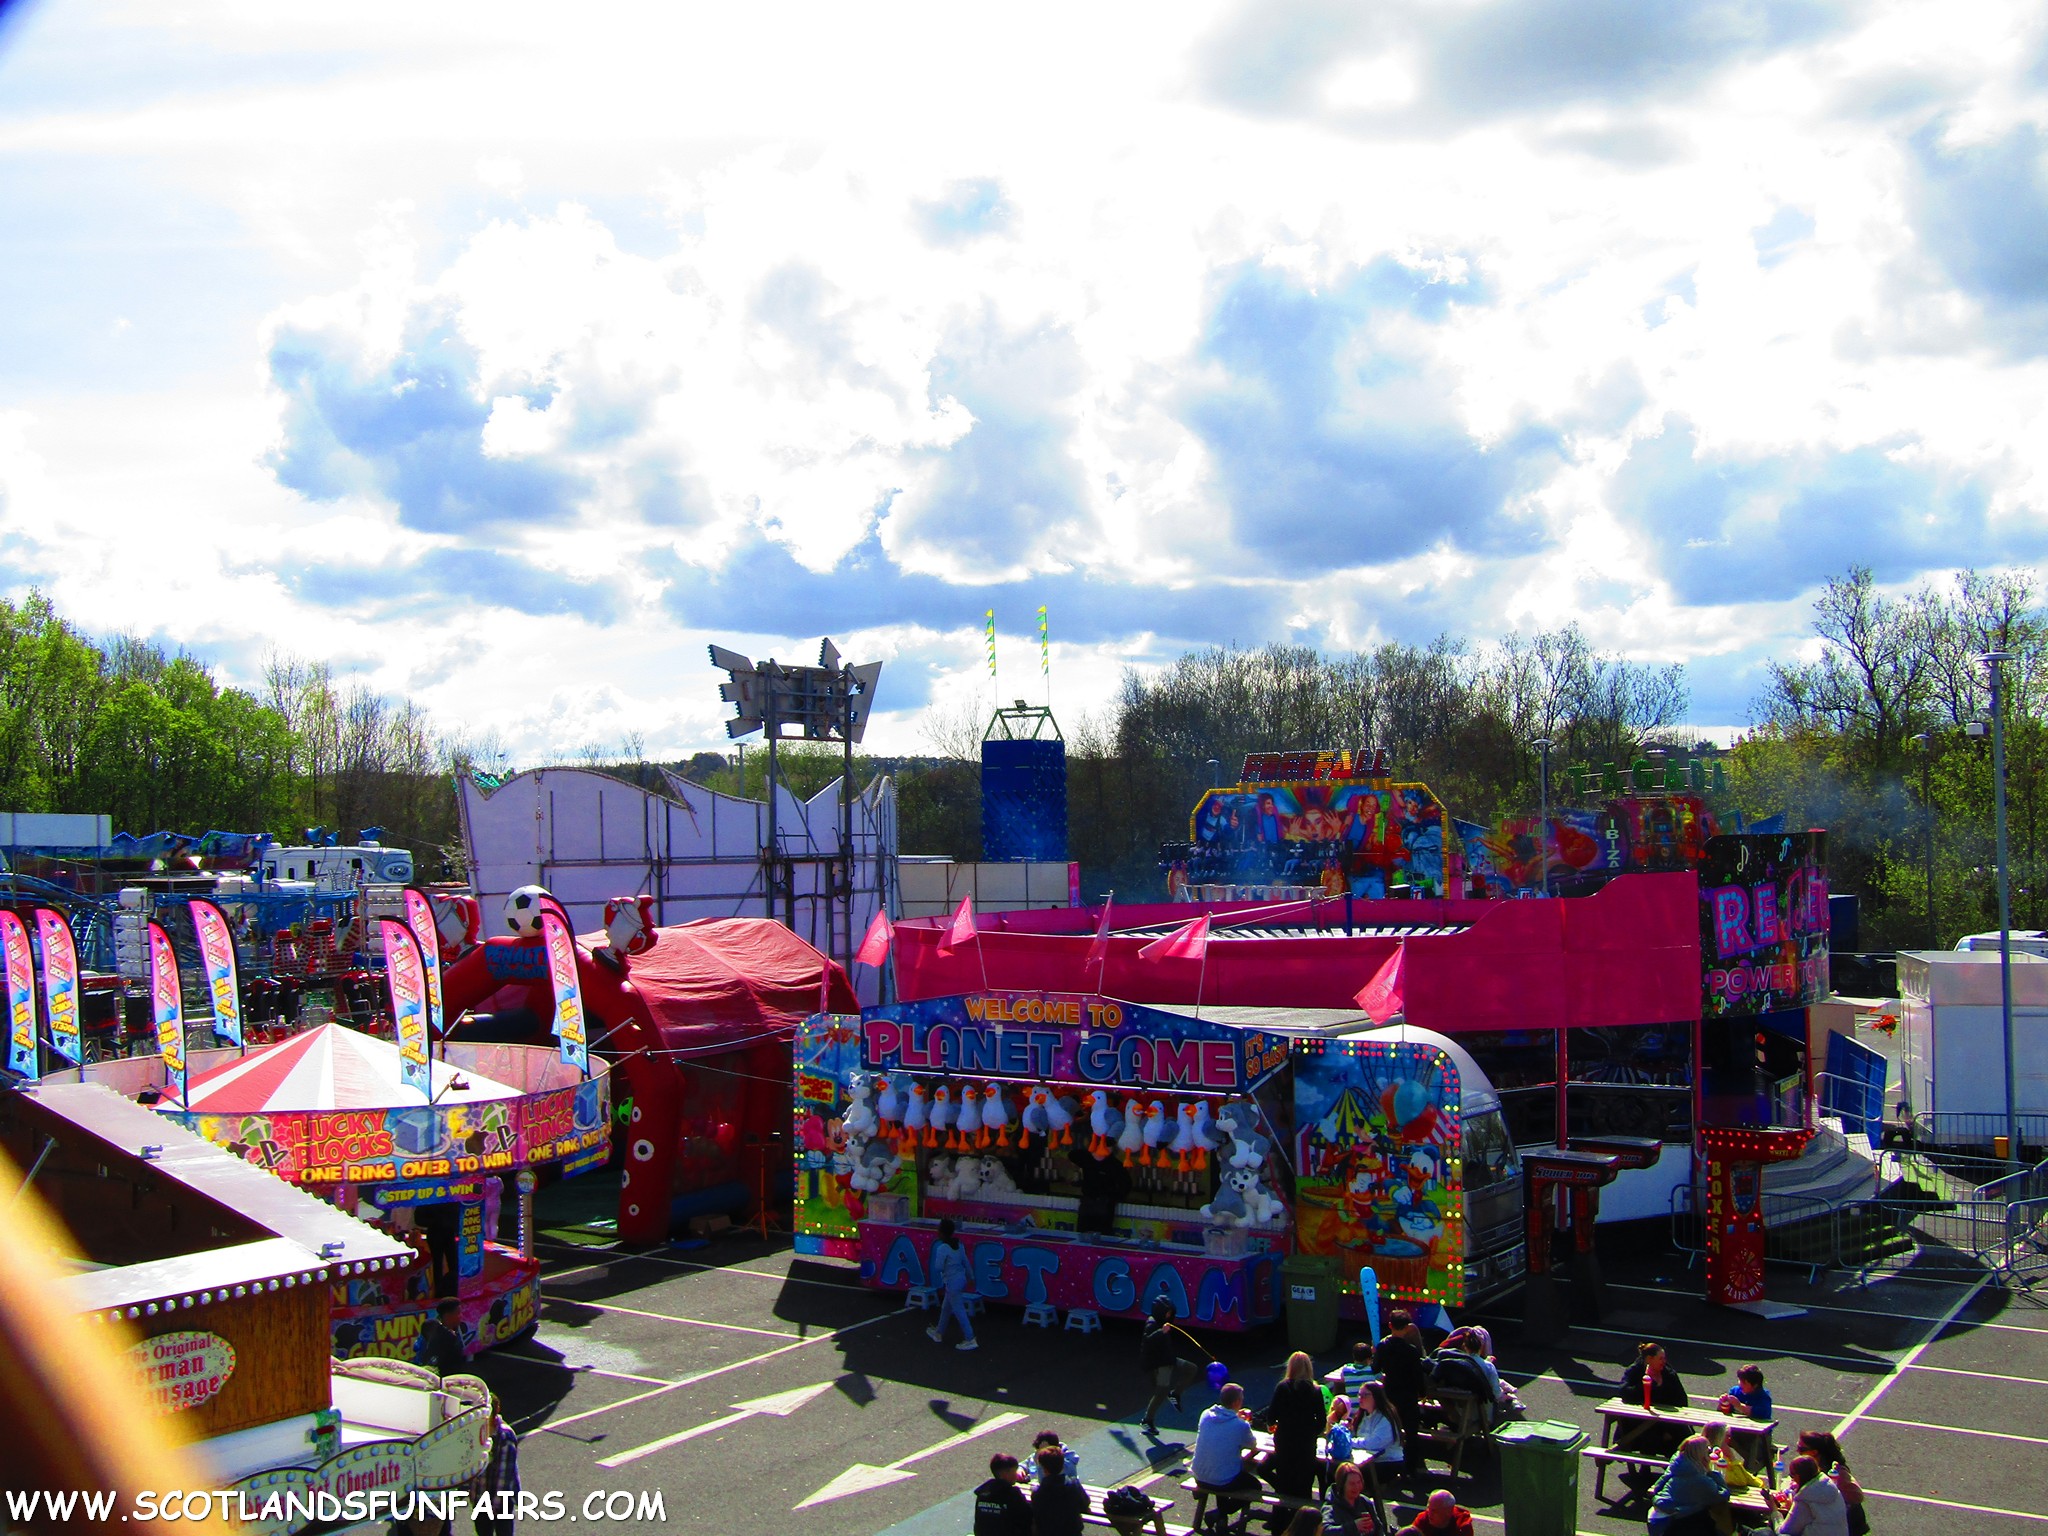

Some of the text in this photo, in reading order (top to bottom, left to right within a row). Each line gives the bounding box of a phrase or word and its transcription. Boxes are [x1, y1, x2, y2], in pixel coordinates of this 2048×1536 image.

[1605, 818, 1621, 869] IBIZA
[1710, 964, 1794, 996] POWER
[1799, 959, 1815, 985] TO
[965, 997, 1123, 1029] WELCOME TO
[864, 1019, 1238, 1087] PLANET GAME
[1245, 1033, 1264, 1058] IT'S
[1246, 1056, 1261, 1079] SO
[521, 1087, 577, 1124] LUCKY
[292, 1108, 389, 1144] LUCKY
[525, 1108, 575, 1147] RINGS
[293, 1131, 395, 1172] BLOCKS
[527, 1145, 553, 1163] ONE
[555, 1137, 580, 1157] RING
[581, 1131, 599, 1150] OVER
[301, 1150, 513, 1184] ONE RING OVER TO WIN
[386, 1182, 474, 1201] STEP UP & WIN
[1711, 1160, 1723, 1254] BOXER
[463, 1216, 481, 1227] RING
[464, 1206, 481, 1217] ONE
[462, 1225, 482, 1236] OVER
[467, 1235, 477, 1244] TO
[465, 1244, 478, 1255] WIN
[511, 1283, 533, 1312] WIN
[1748, 1280, 1765, 1297] WIN
[375, 1312, 428, 1341] WIN
[495, 1301, 535, 1341] GAMES
[153, 1335, 212, 1360] Original
[135, 1355, 206, 1387] erman
[146, 1375, 220, 1403] ausage
[336, 1459, 401, 1499] Chocolate
